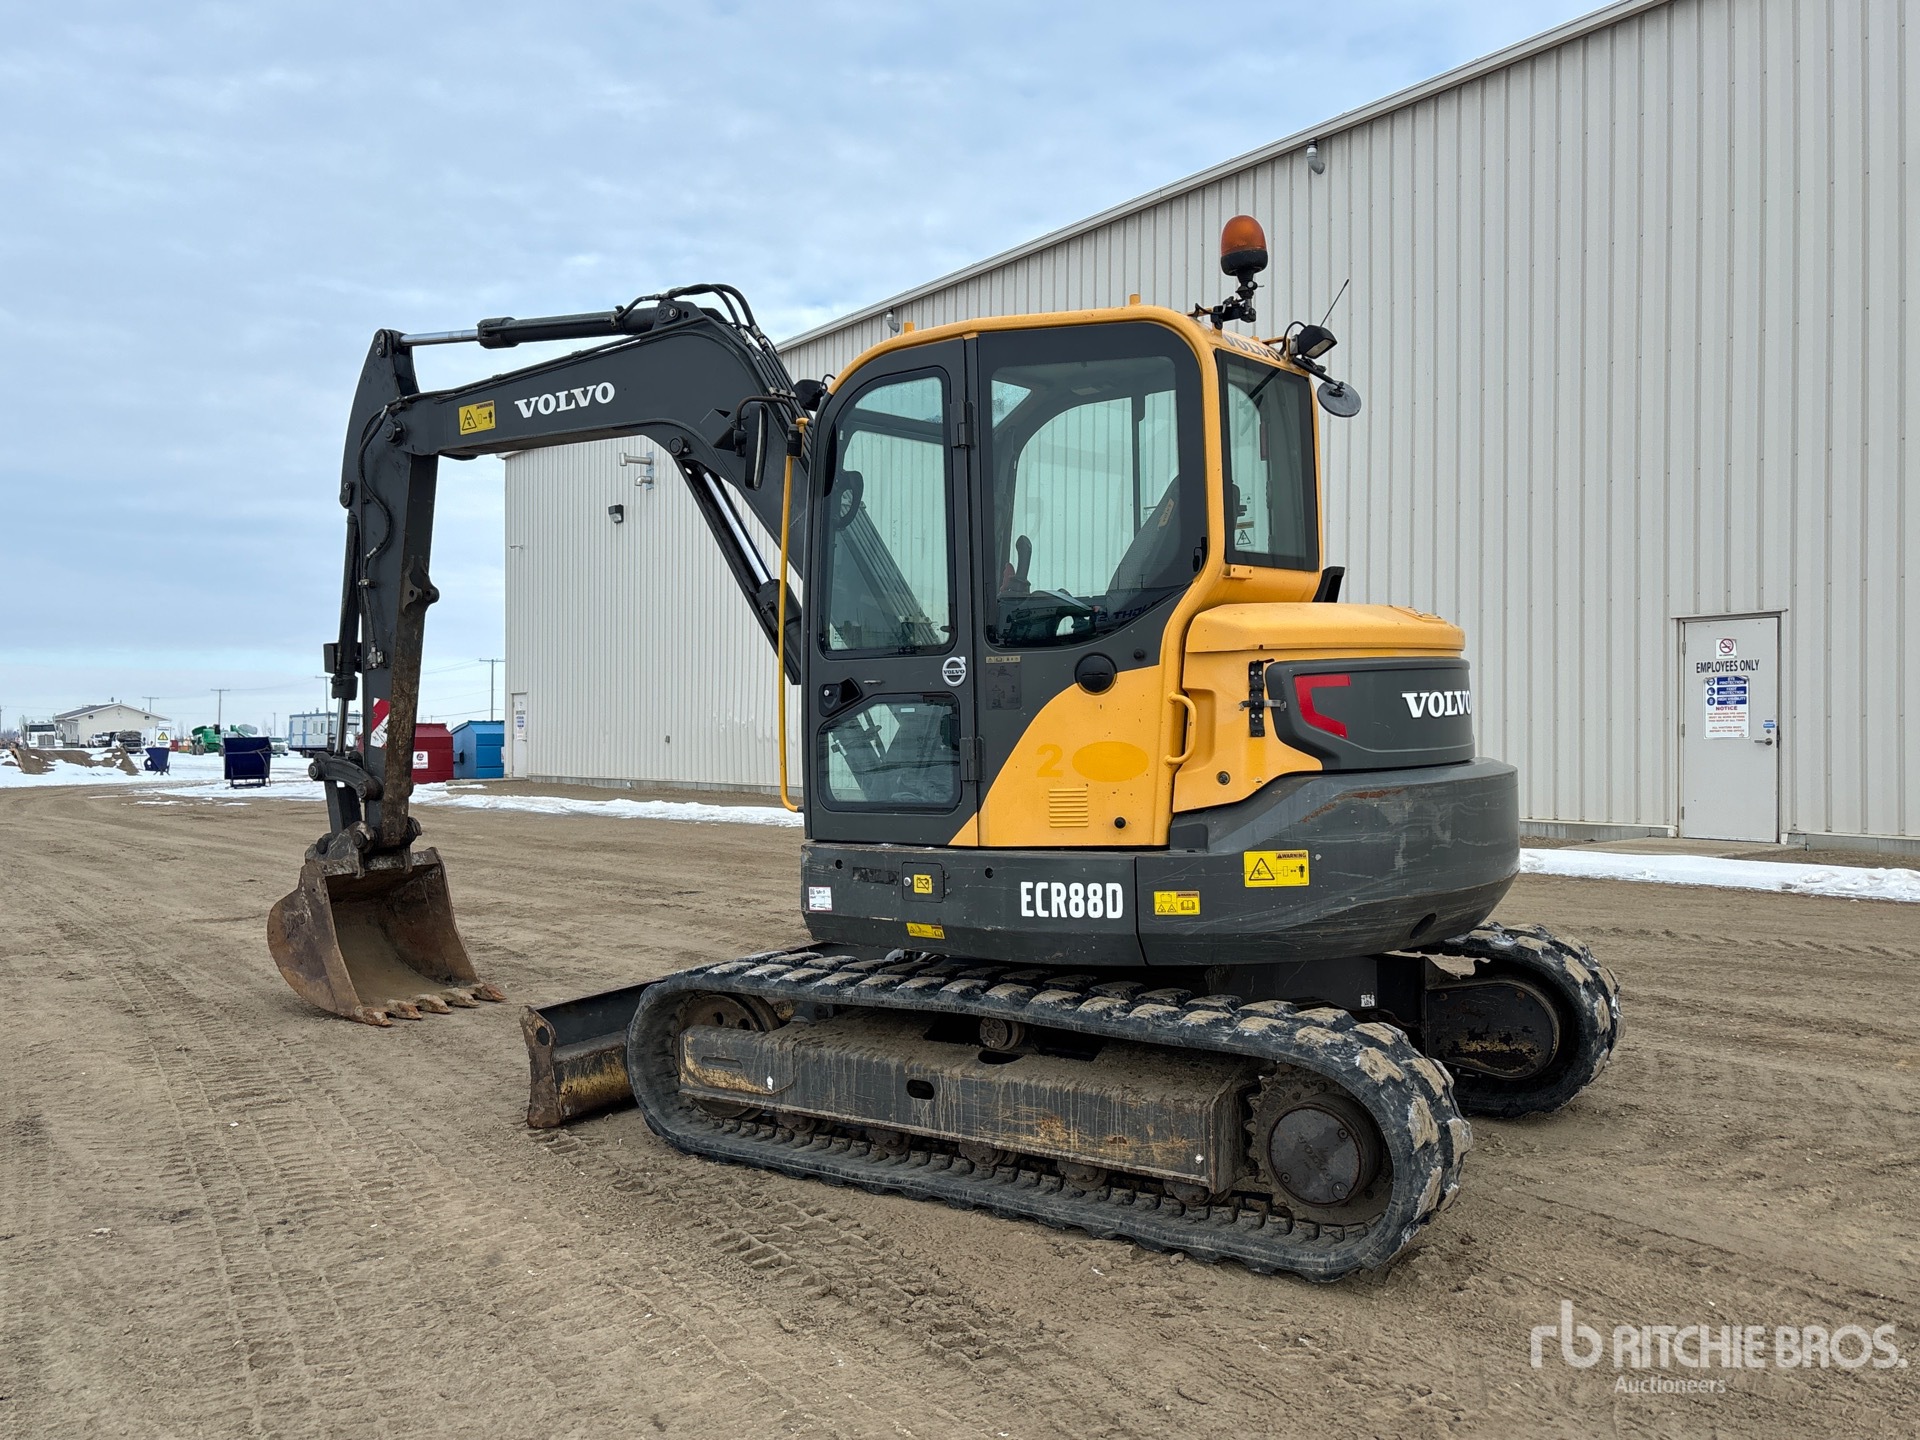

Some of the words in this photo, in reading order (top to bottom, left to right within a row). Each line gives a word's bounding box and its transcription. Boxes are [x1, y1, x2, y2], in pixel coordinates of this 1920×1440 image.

[1223, 334, 1281, 362] VOLVO
[514, 381, 616, 419] VOLVO
[1696, 661, 1738, 674] EMPLOYEES
[1740, 659, 1760, 671] ONLY
[1401, 689, 1472, 719] VOLVO
[1036, 743, 1064, 778] 2
[1020, 881, 1124, 919] ECR88D
